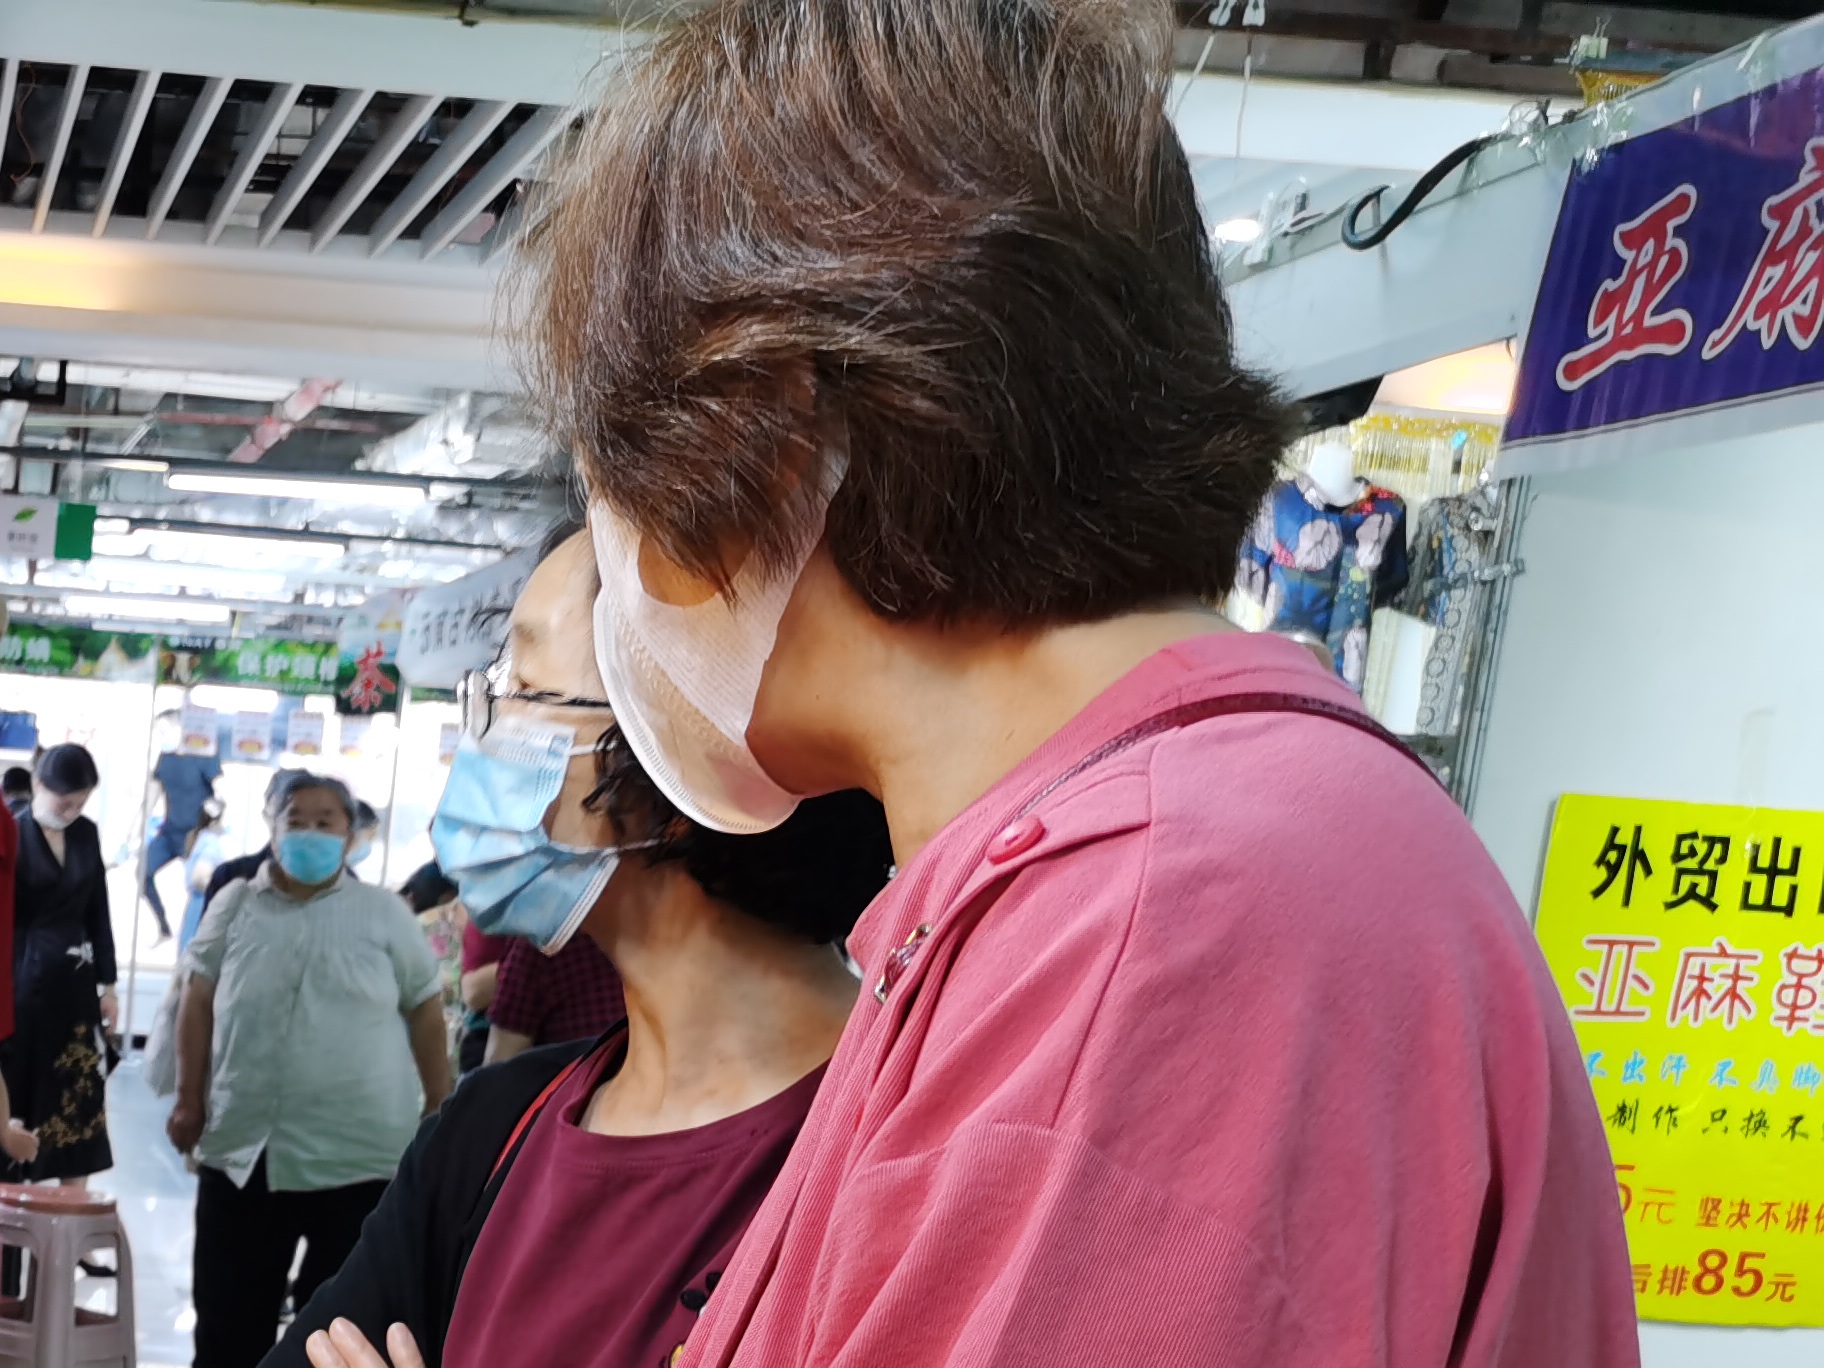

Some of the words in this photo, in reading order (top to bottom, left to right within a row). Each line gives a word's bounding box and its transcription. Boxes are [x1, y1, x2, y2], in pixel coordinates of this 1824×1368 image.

[1556, 136, 1824, 391] 亚麻
[341, 638, 397, 713] 茶
[1589, 823, 1824, 918] 外贸出
[1702, 1107, 1824, 1143] 只换不
